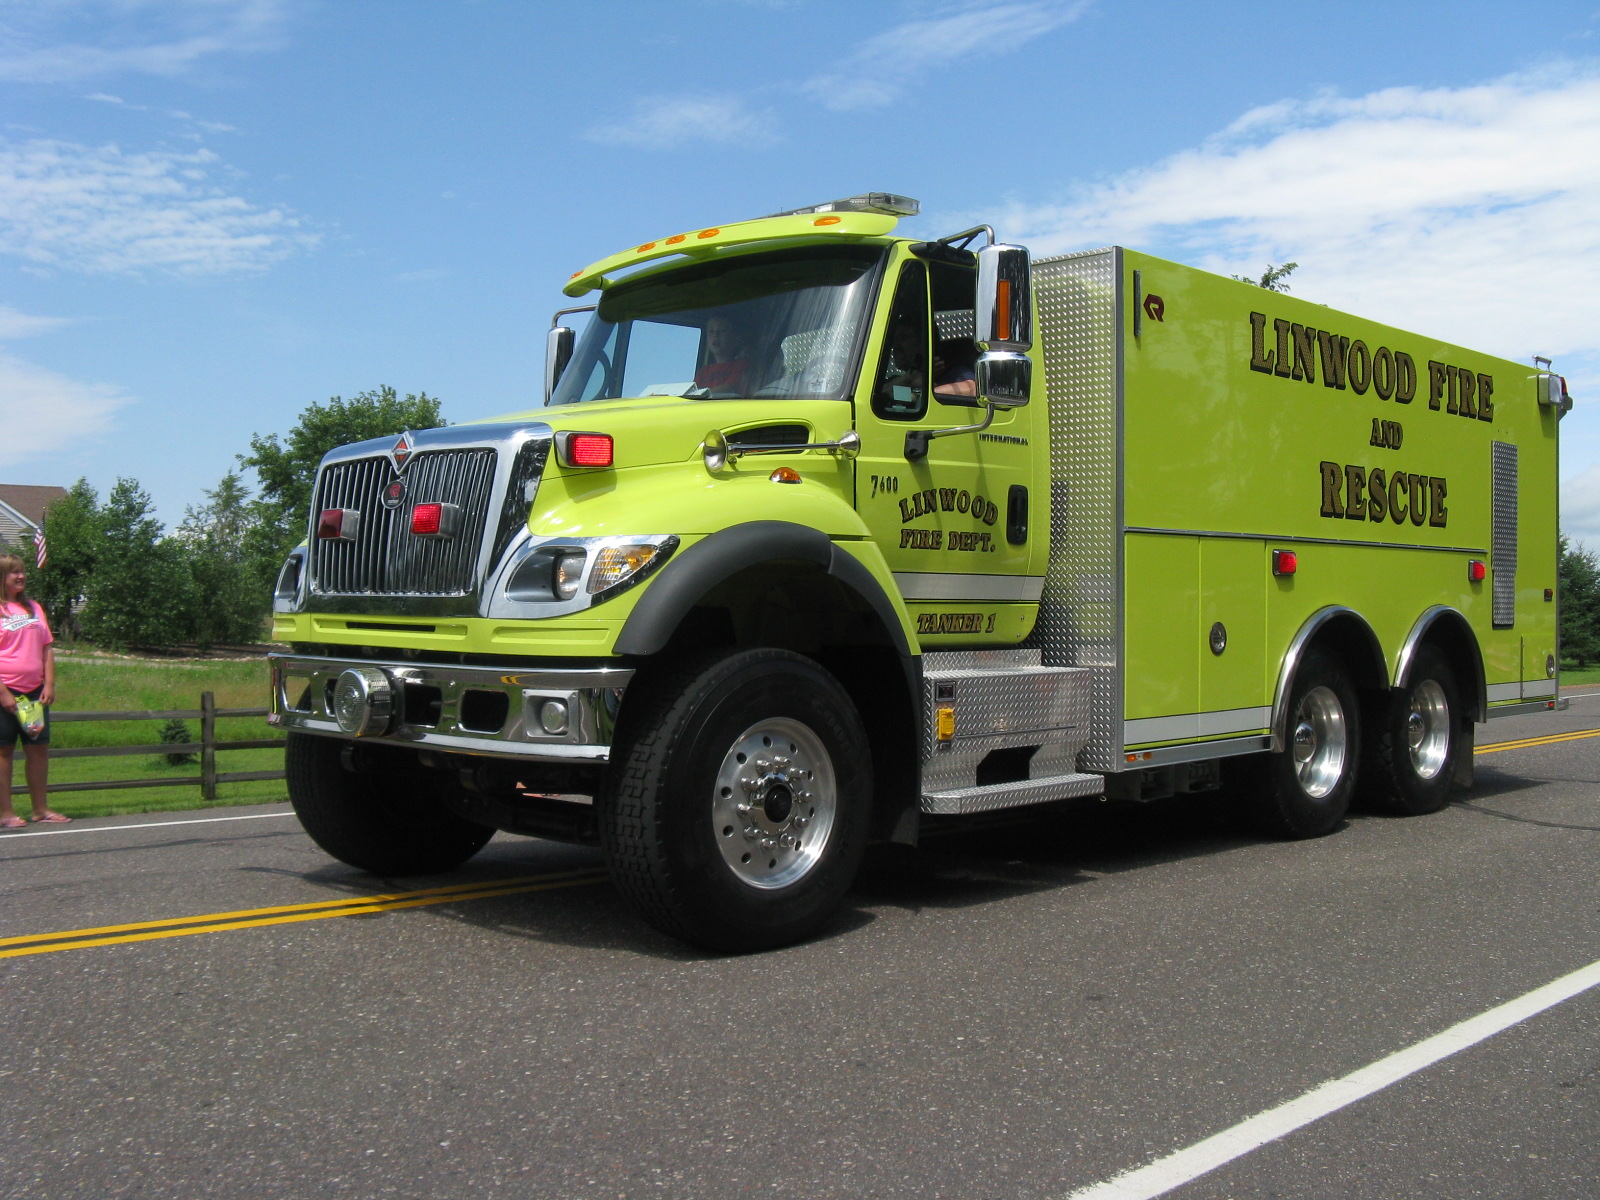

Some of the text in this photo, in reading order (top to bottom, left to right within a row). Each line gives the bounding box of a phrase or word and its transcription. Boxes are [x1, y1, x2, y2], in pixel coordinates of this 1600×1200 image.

[1250, 311, 1494, 423] LINWOOD FIRE
[979, 432, 1029, 446] INTERNATIONAL
[1369, 418, 1403, 450] AND
[870, 475, 898, 499] 7600
[1320, 461, 1448, 529] RESCUE
[899, 488, 999, 527] LINWOOD
[899, 529, 996, 552] FIRE DEPT.
[917, 612, 997, 634] TANKER 1
